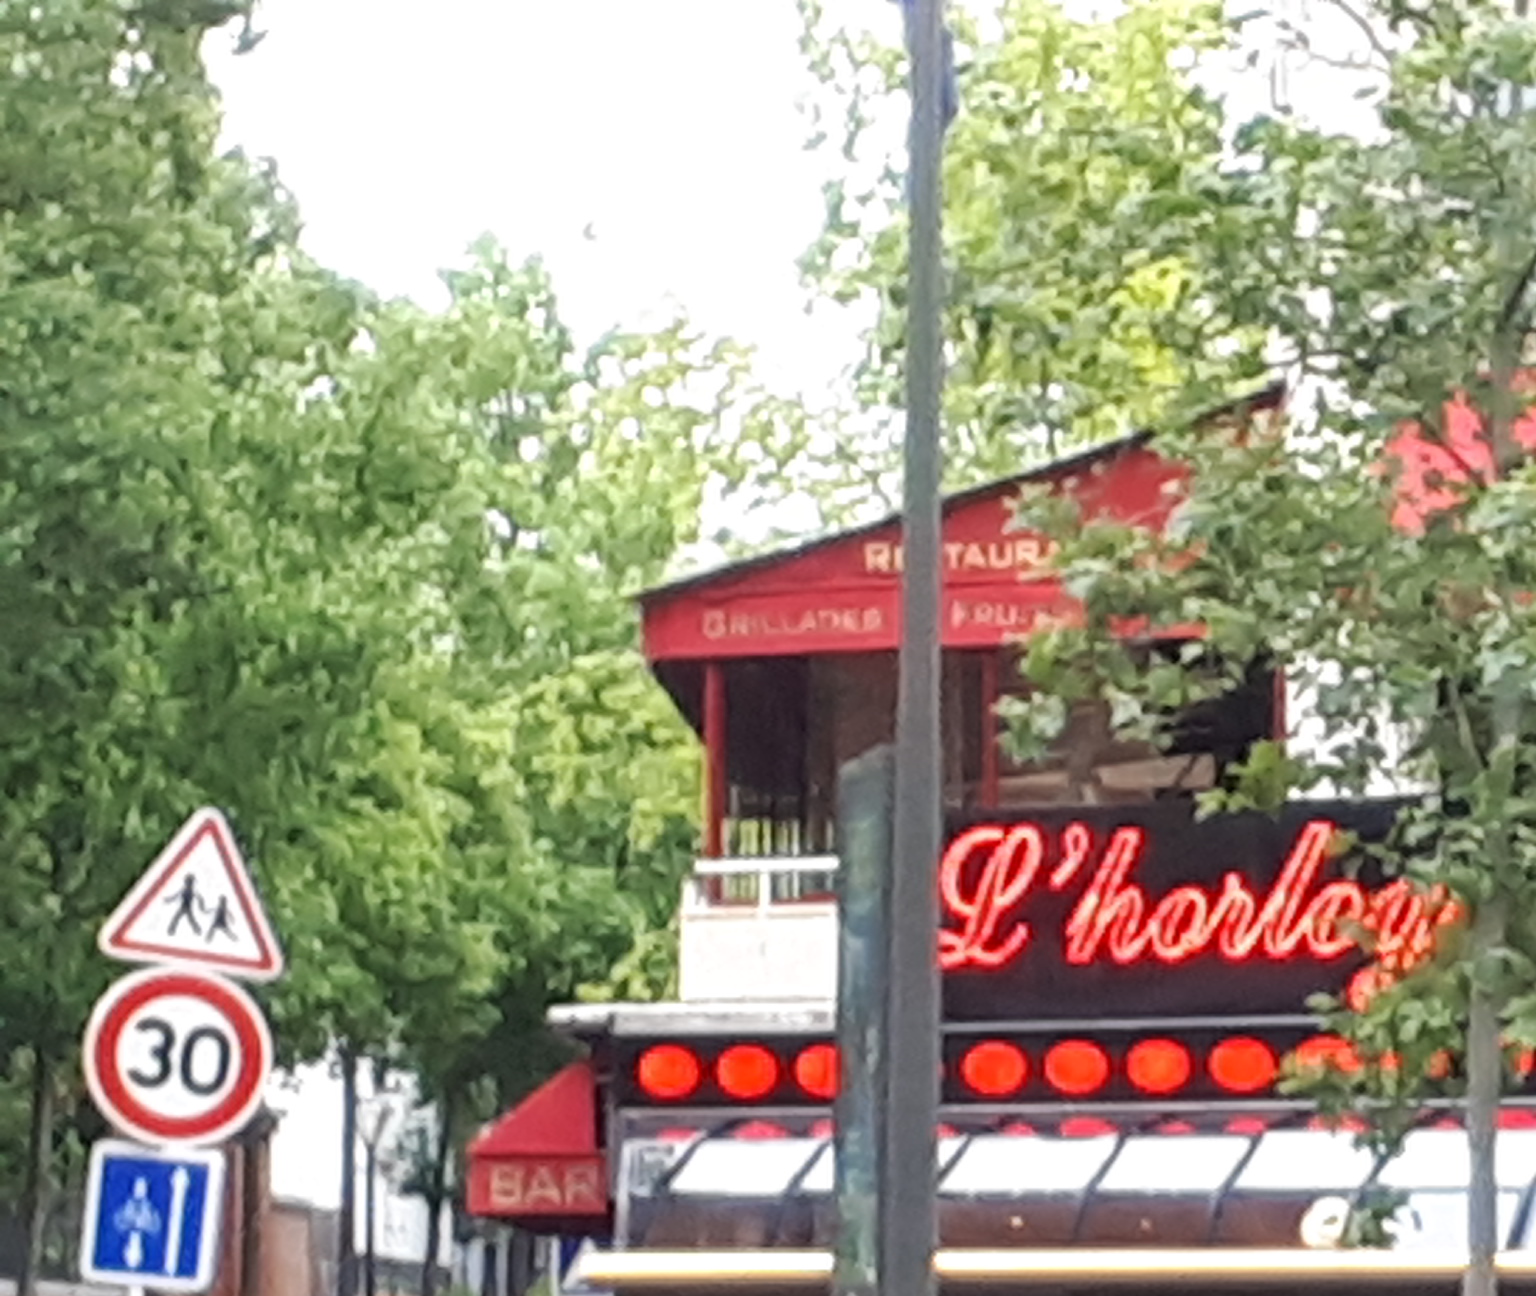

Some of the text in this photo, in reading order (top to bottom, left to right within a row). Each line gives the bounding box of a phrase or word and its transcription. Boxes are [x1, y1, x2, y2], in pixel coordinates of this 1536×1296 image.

[702, 607, 883, 640] GRILLADES
[126, 1016, 233, 1097] 30
[489, 1161, 600, 1208] BAR
